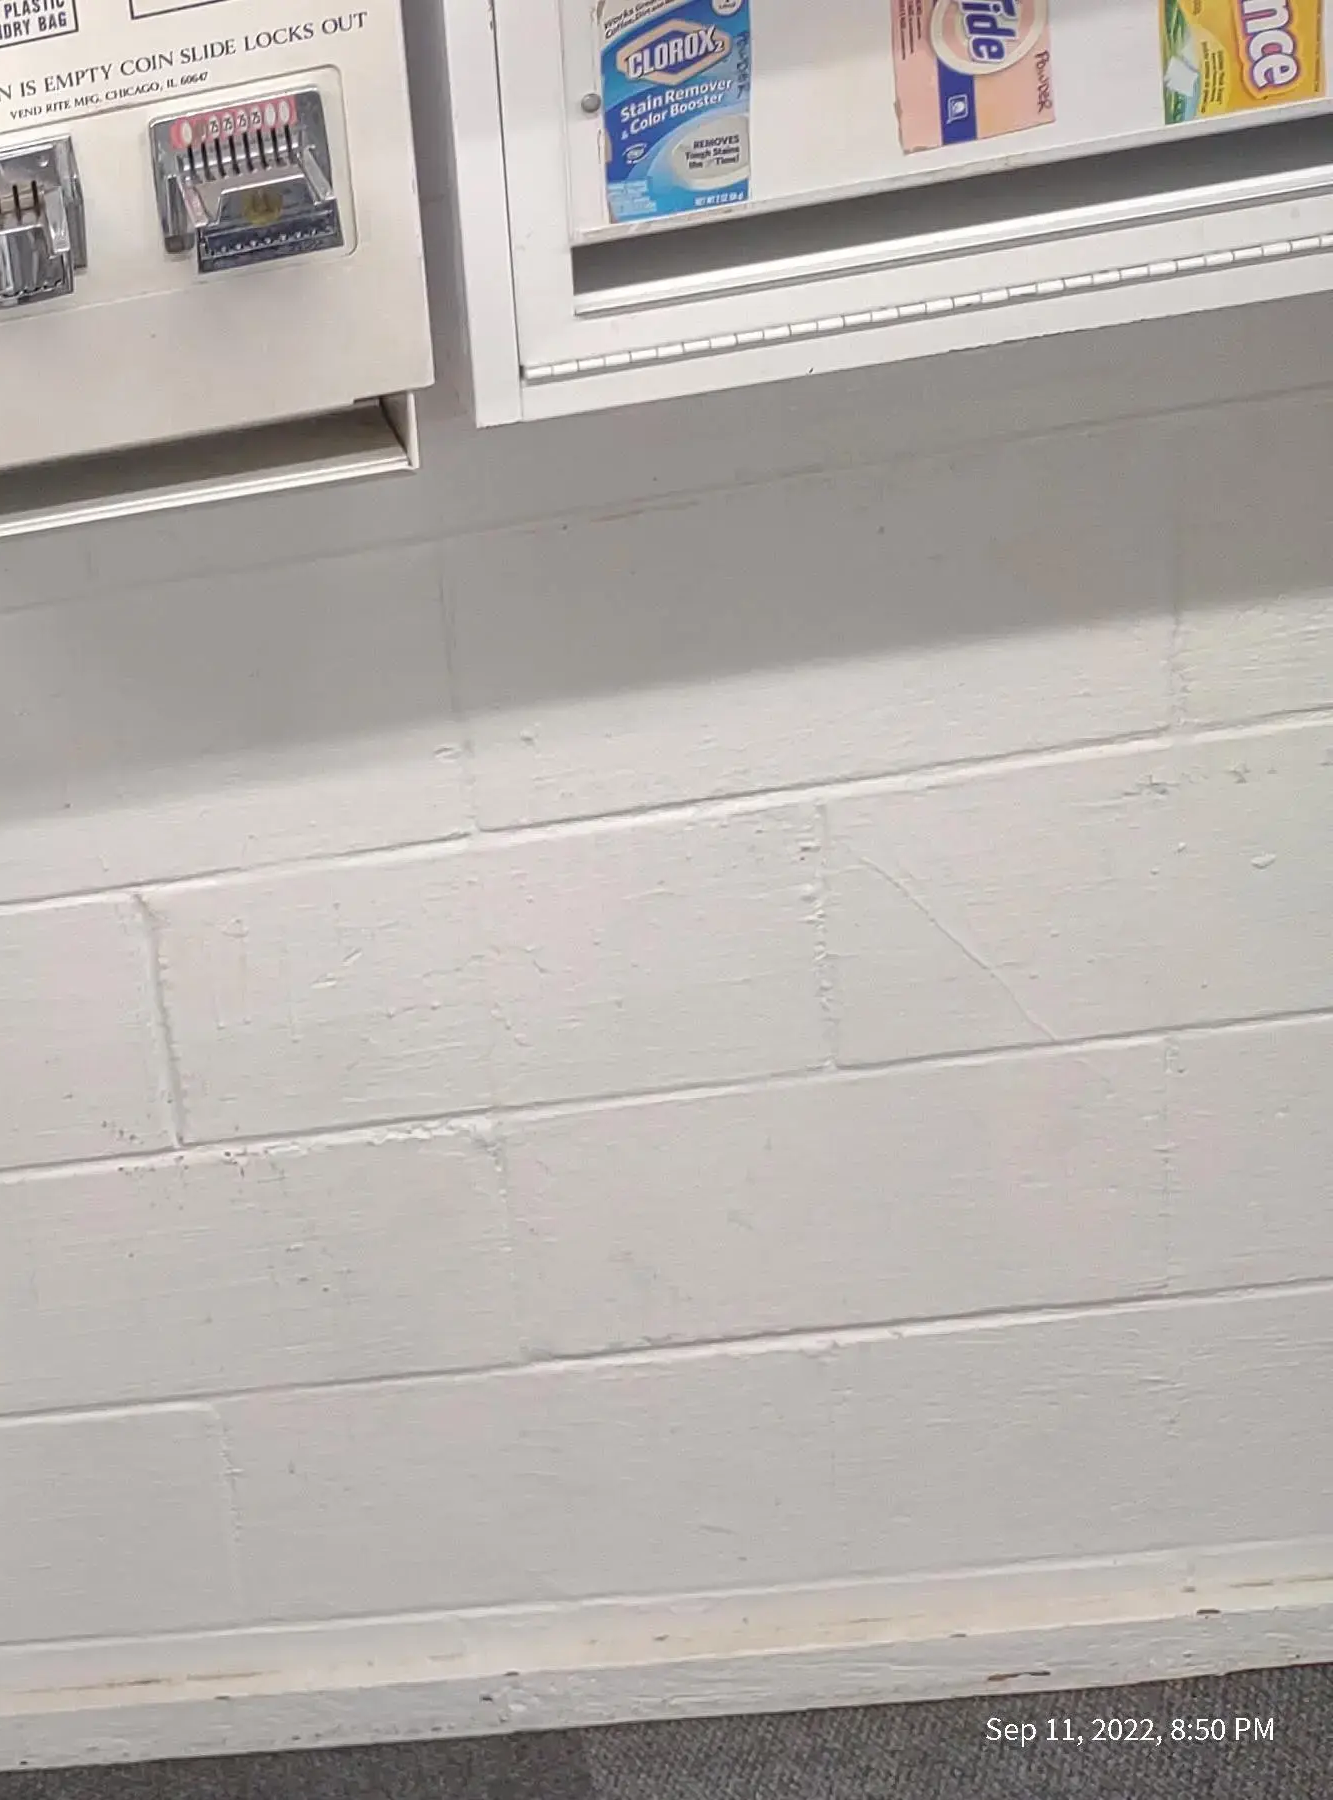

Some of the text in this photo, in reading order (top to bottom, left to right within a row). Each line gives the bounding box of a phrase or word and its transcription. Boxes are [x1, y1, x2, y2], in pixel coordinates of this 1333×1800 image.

[4, 0, 65, 21] PLASTIC
[38, 12, 67, 32] BAG
[20, 79, 37, 98] IS
[44, 63, 113, 93] EMPTY
[120, 51, 174, 76] COIN
[180, 38, 237, 64] SLIDE
[244, 22, 314, 51] LOCKS
[322, 11, 368, 35] OUT
[10, 104, 42, 120] VEND
[46, 98, 71, 113] RITE
[167, 78, 178, 88] IL
[620, 79, 732, 123] Stain Remover
[630, 110, 668, 135] Color
[670, 92, 724, 118] Booster
[693, 135, 740, 149] REMOVES
